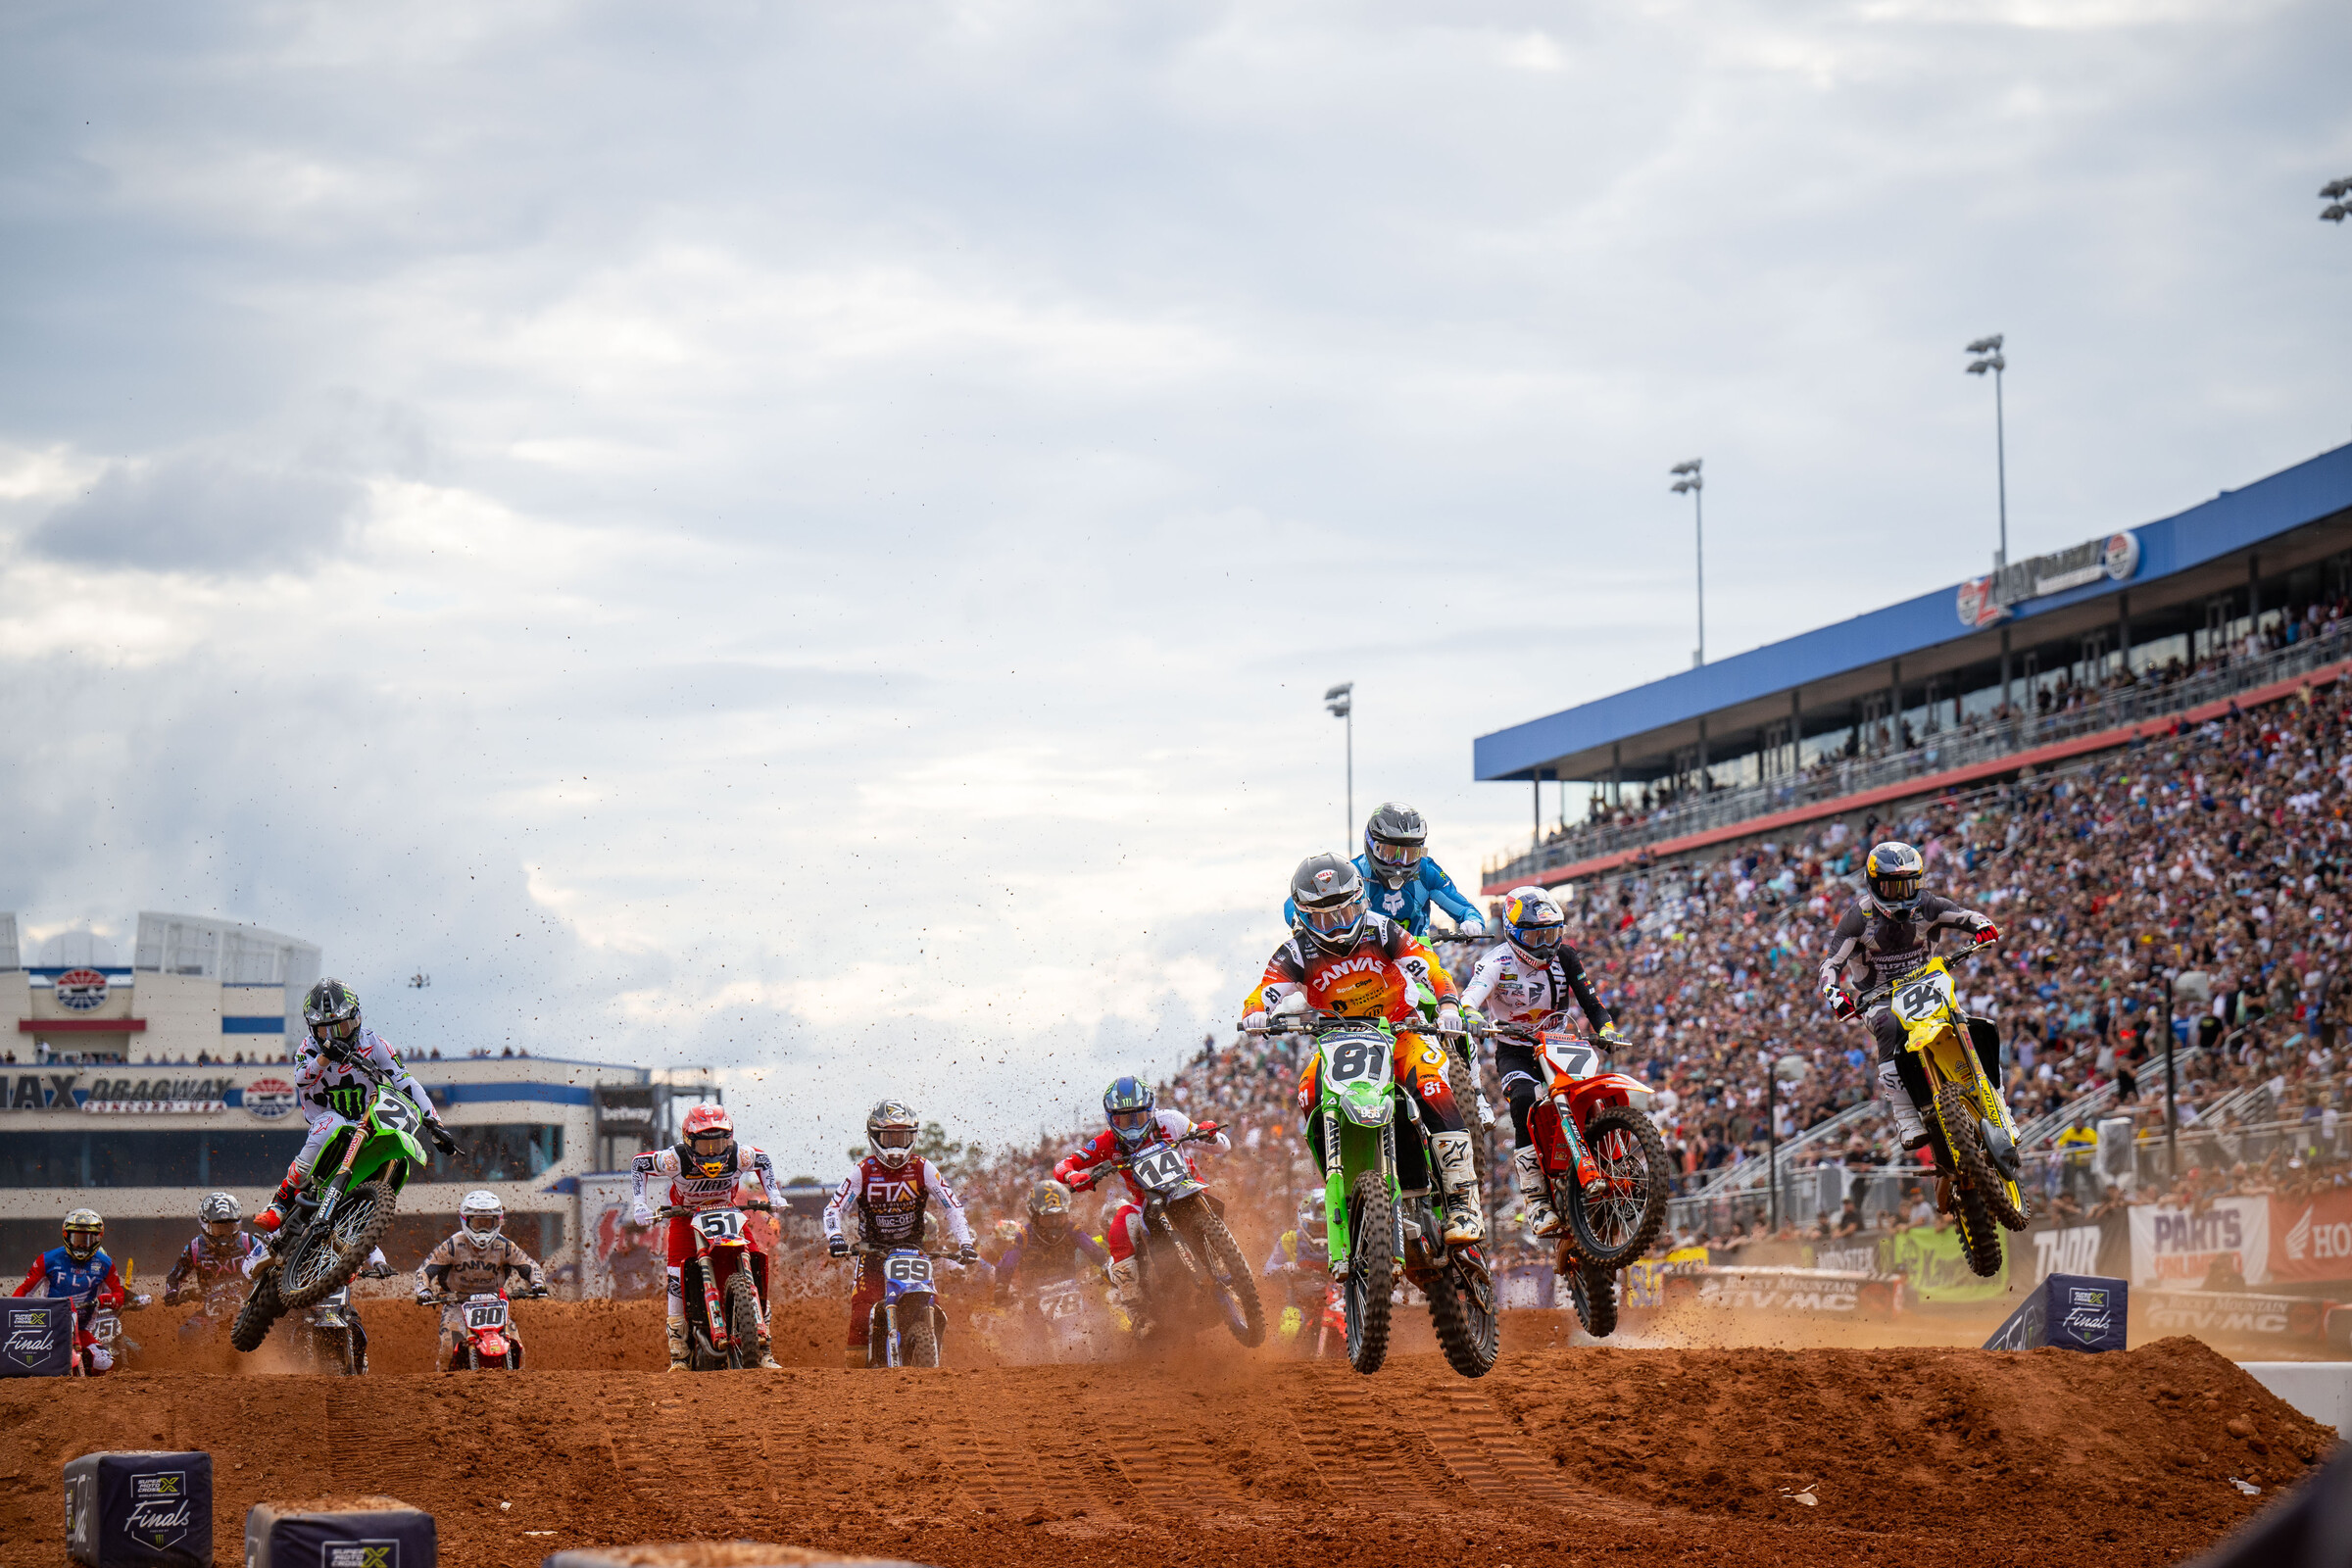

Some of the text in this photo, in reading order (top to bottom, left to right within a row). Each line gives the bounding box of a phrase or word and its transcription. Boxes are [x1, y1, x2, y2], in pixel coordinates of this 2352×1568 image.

[1312, 956, 1387, 990] CANVAS
[1405, 959, 1427, 978] 81
[1874, 956, 1924, 971] SUZUKI
[1264, 986, 1282, 1004] 81
[1902, 979, 1943, 1021] 94
[1332, 1043, 1387, 1082] 81
[1557, 1047, 1592, 1074] 7
[86, 1078, 233, 1101] DRAGWAY
[1423, 1081, 1442, 1098] 81
[375, 1098, 418, 1136] 21
[602, 1106, 654, 1123] betway
[1983, 1089, 2001, 1128] DUNLOP
[1565, 1132, 1581, 1160] MOTOREX
[1139, 1152, 1184, 1186] 14
[318, 1187, 336, 1219] DUNLOP
[701, 1213, 738, 1238] 51
[878, 1213, 915, 1225] Muc-Off
[2154, 1207, 2243, 1253] PARTS
[2313, 1222, 2352, 1259] HO
[1174, 1241, 1198, 1273] DUNLOP
[2033, 1225, 2103, 1287] THOR
[57, 1271, 97, 1288] FLY
[890, 1259, 930, 1281] 69
[1775, 1276, 1857, 1293] MOUNTAIN
[470, 1306, 504, 1327] 80
[2214, 1296, 2288, 1312] MOUNTAIN
[2062, 1306, 2112, 1330] Finals
[2, 1328, 55, 1352] Finals
[123, 1499, 191, 1532] Finals
